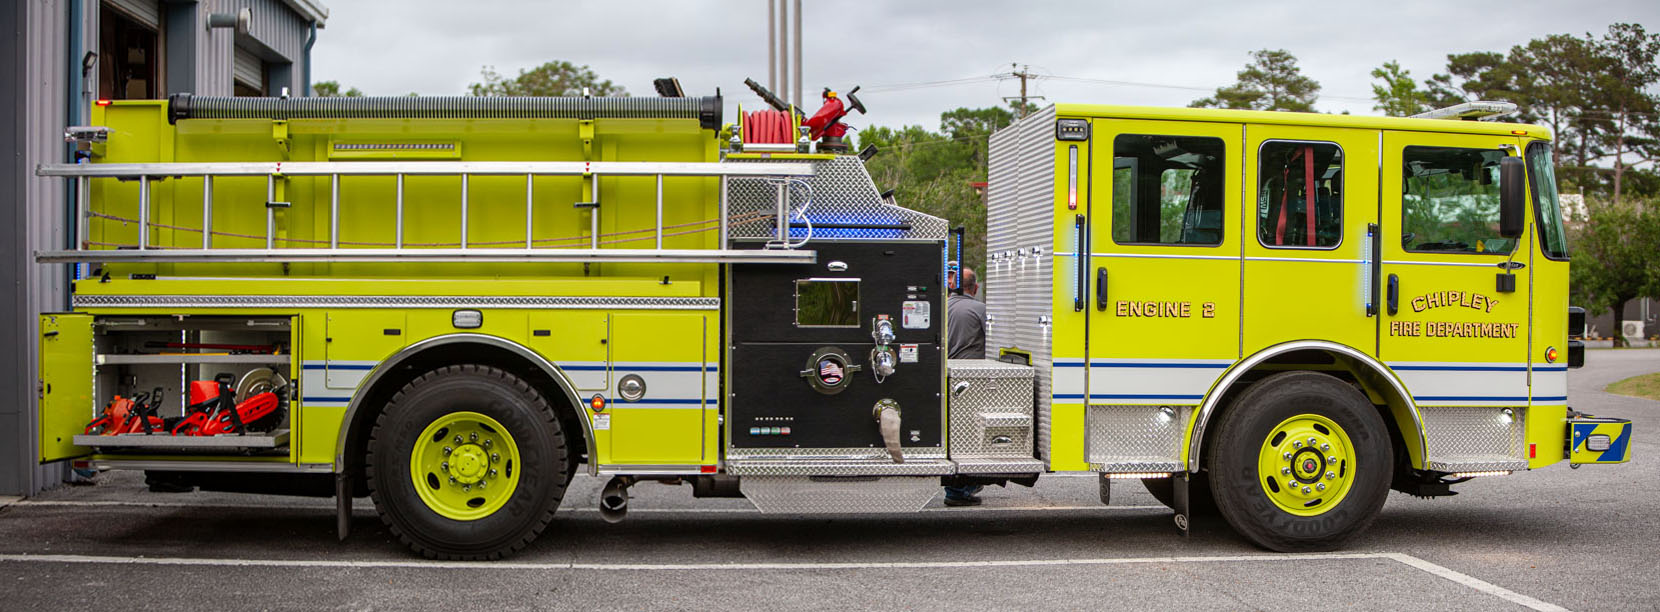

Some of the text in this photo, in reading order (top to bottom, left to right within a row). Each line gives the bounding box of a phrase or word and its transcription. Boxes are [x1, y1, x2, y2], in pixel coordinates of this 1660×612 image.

[1116, 301, 1216, 318] ENGINE 2
[1411, 291, 1499, 313] CHIPLEY
[1390, 321, 1519, 338] FIRE DEPARTMENT
